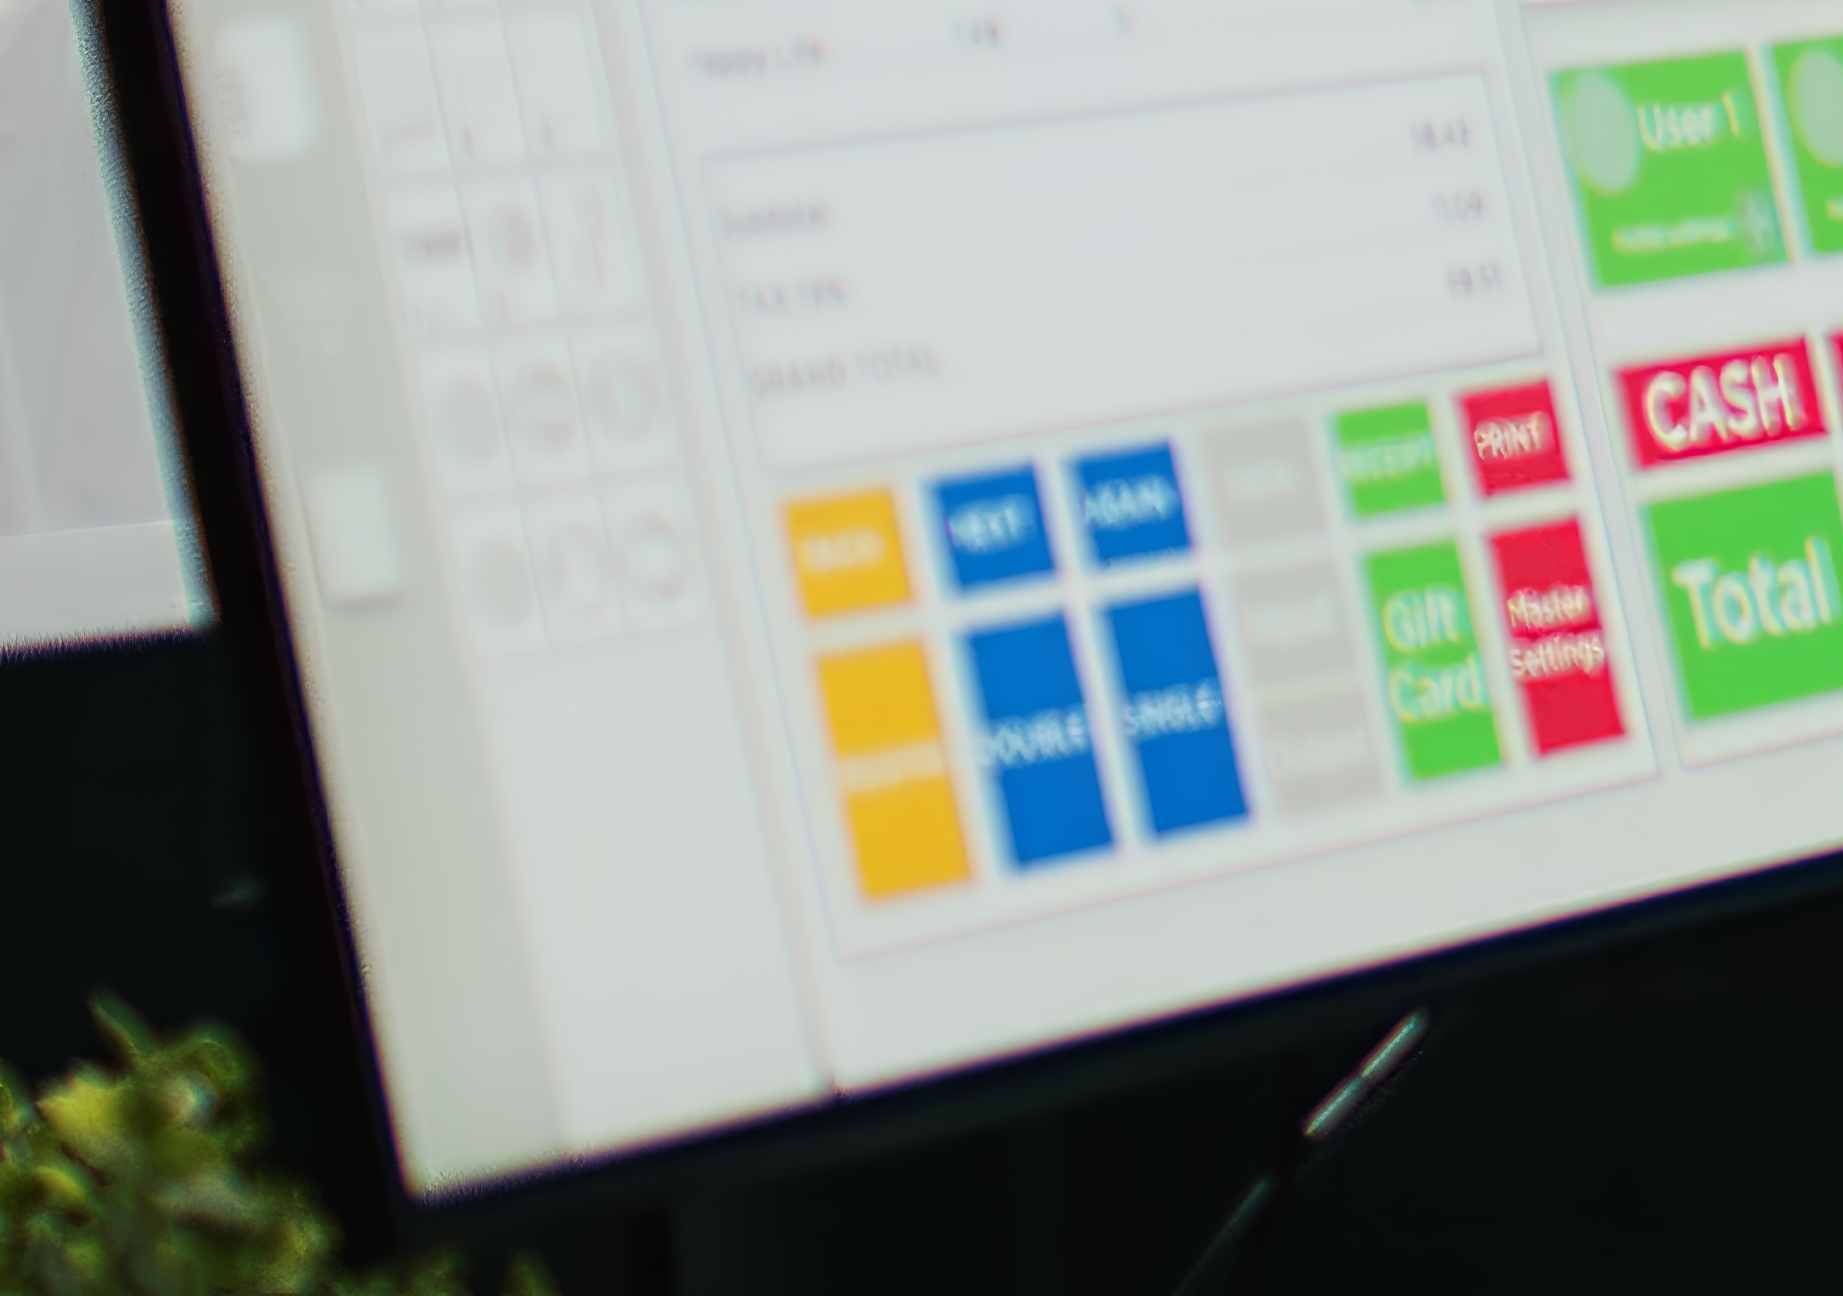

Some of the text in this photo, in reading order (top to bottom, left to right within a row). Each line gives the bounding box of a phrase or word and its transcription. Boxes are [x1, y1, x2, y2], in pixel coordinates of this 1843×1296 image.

[1637, 101, 1718, 151] User
[1644, 351, 1807, 452] CASH
[1472, 411, 1547, 464] PRINT
[1383, 588, 1461, 654] Gift
[1672, 535, 1842, 651] Total
[1509, 627, 1604, 679] Settings
[1387, 655, 1484, 725] Card
